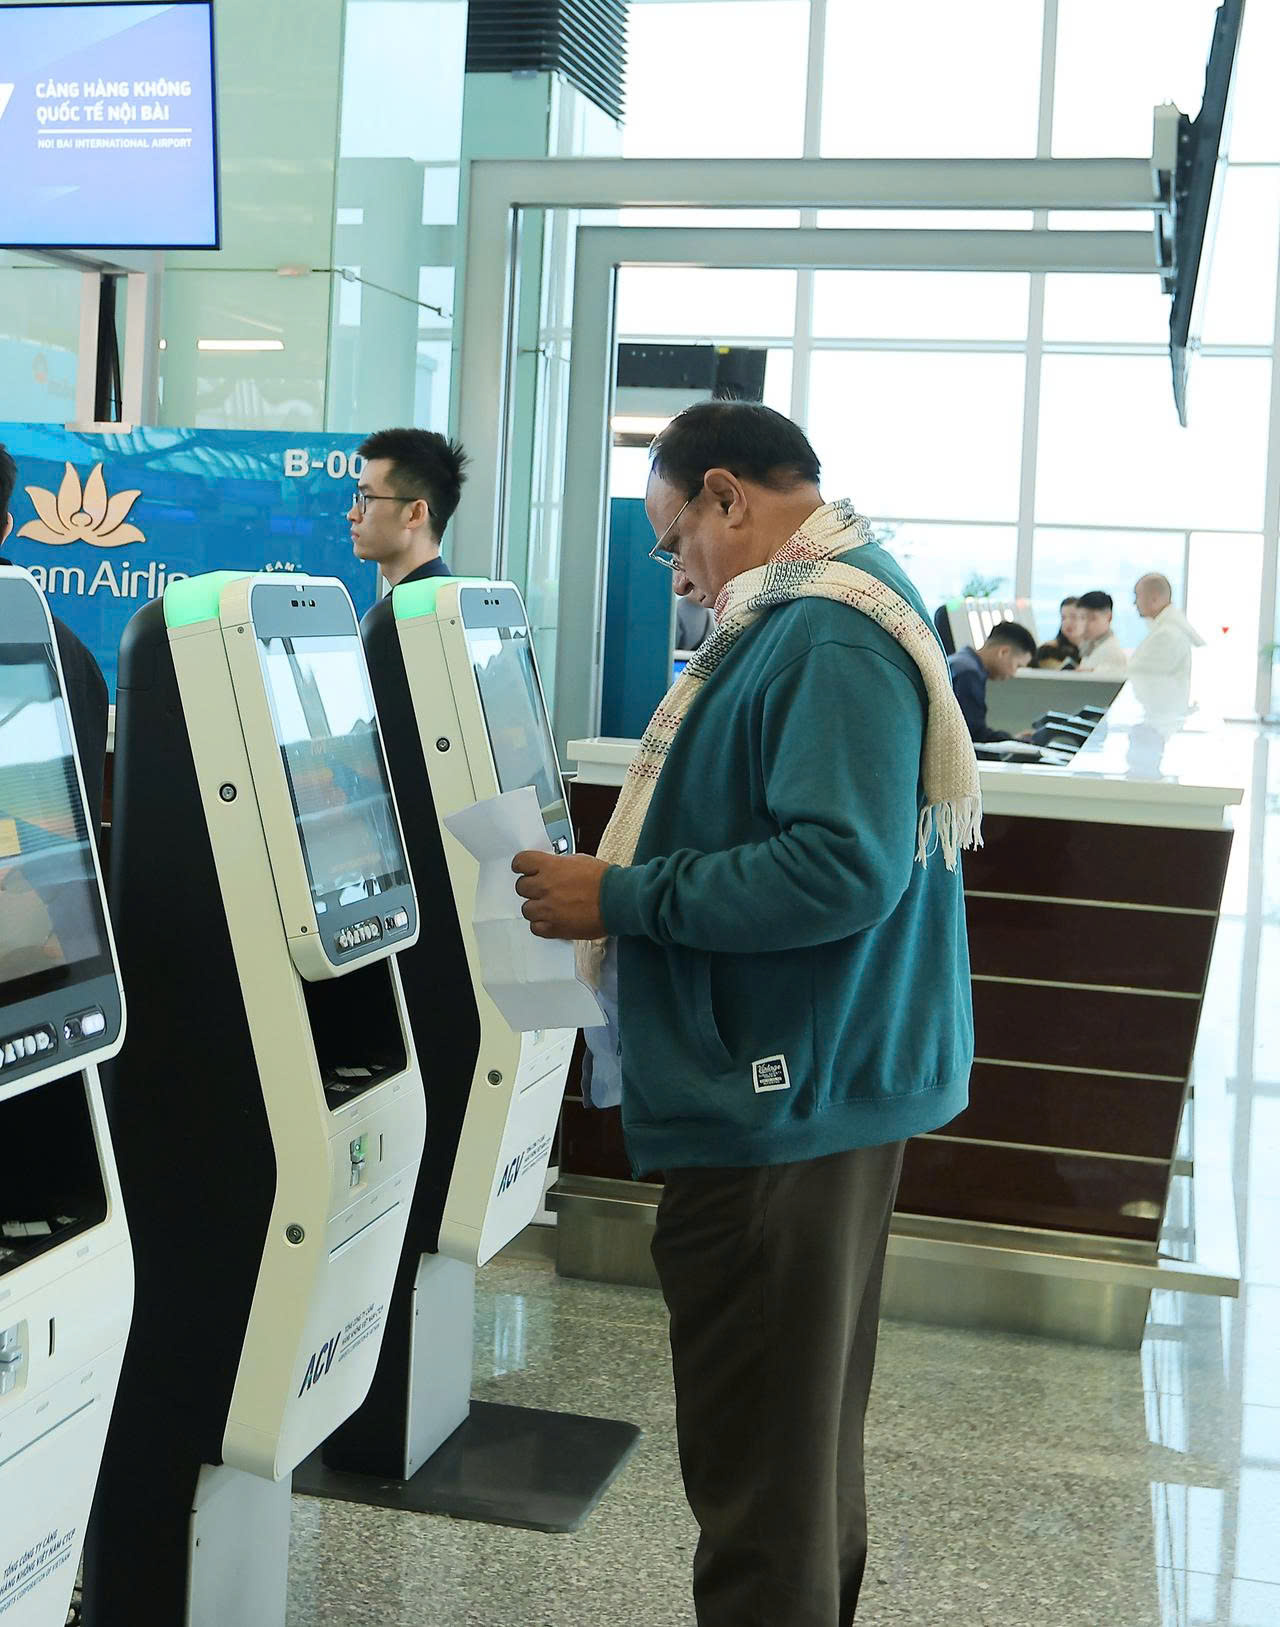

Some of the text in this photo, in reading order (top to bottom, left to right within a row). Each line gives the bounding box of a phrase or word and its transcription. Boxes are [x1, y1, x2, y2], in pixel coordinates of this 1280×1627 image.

[35, 77, 192, 98] CẢNG HÀNG KHÔNG
[37, 100, 169, 125] QUỐC TẾ NỘI BÀI
[75, 138, 149, 149] INTERNATIONAL
[152, 138, 192, 148] AIRPORT
[284, 448, 368, 479] B-00
[497, 1151, 525, 1197] ACV
[298, 1331, 341, 1398] ACV
[48, 1539, 62, 1556] NAM
